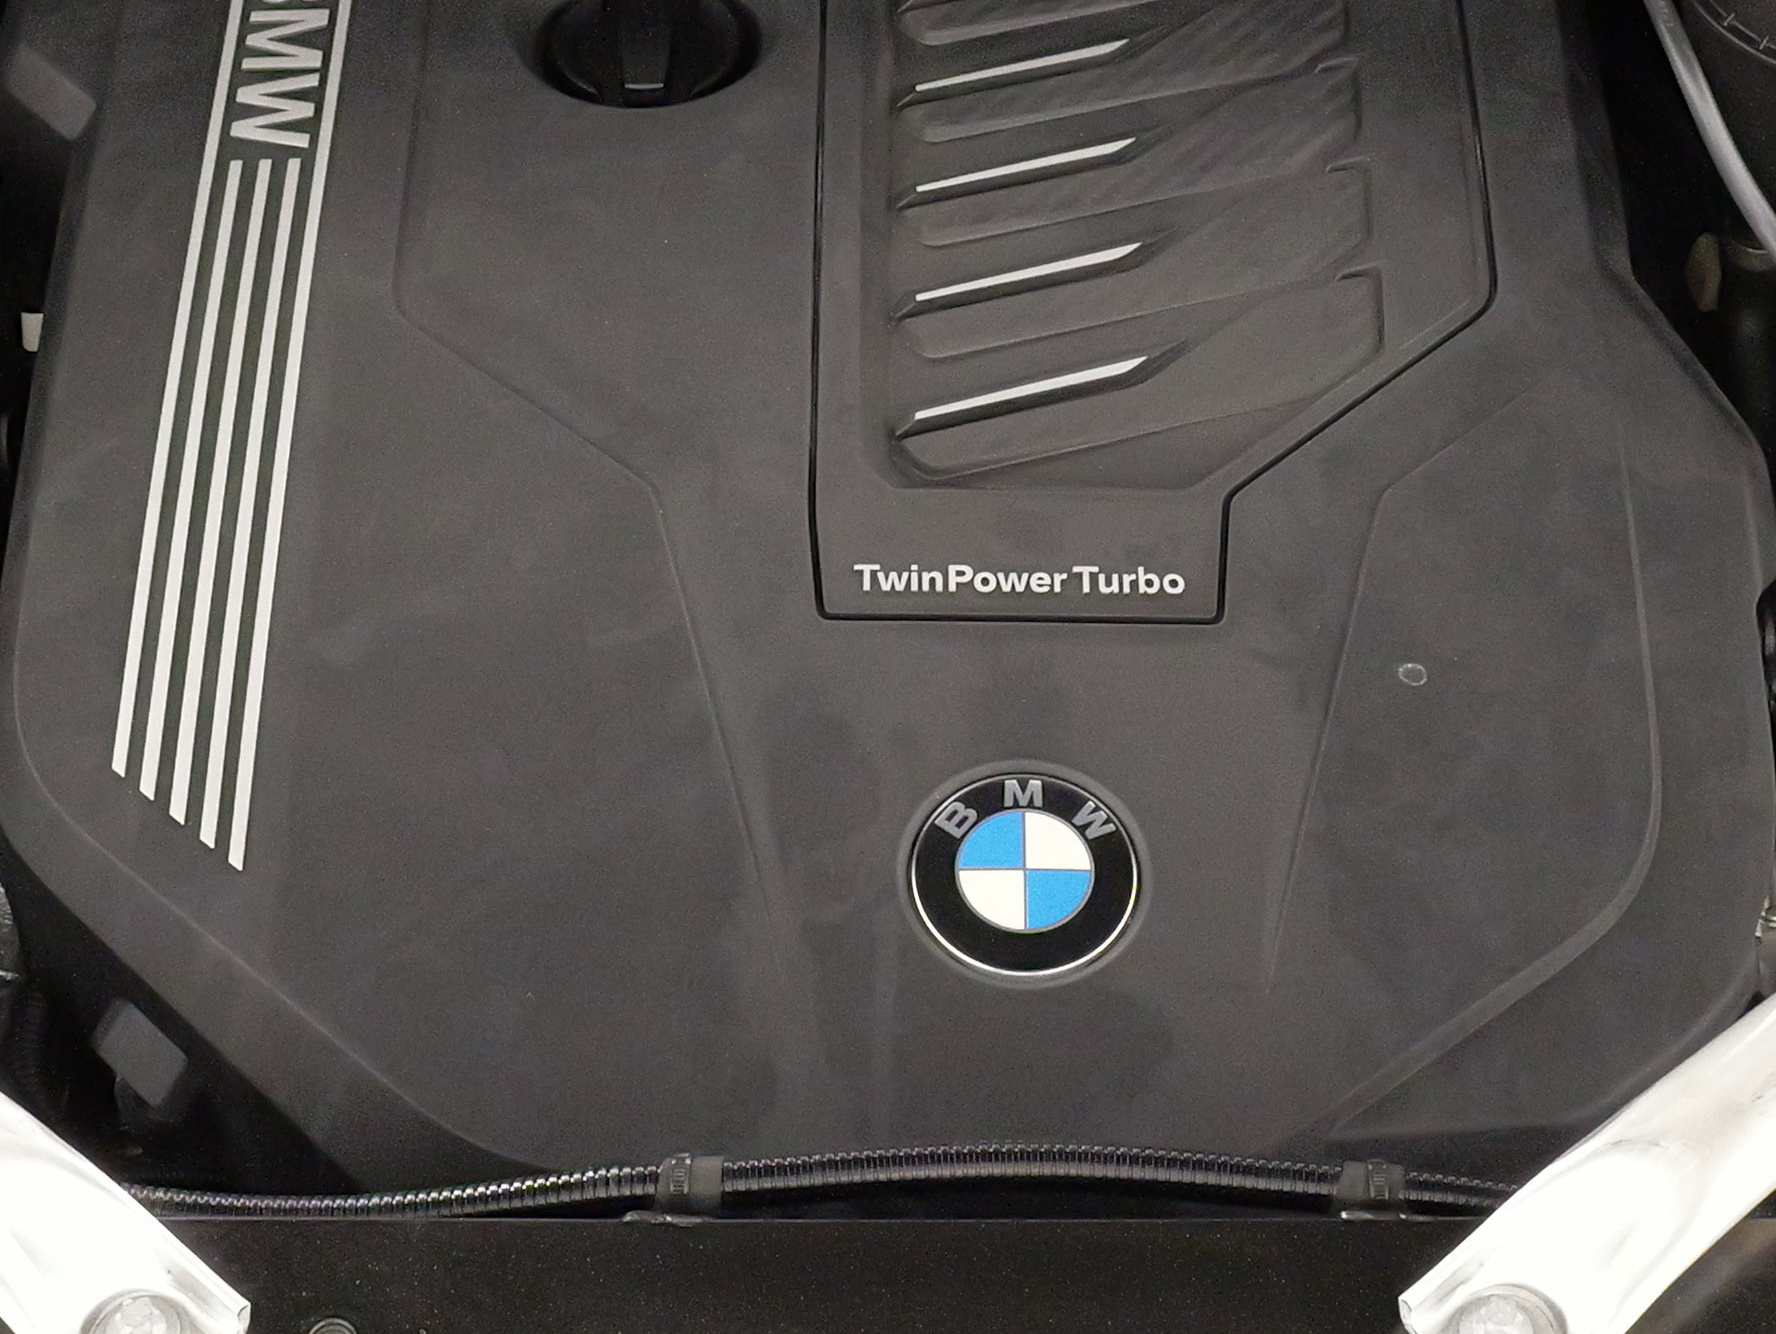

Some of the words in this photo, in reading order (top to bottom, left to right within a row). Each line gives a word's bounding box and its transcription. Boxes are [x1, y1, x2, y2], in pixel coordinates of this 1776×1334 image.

[853, 563, 1068, 594] TwinPower
[1073, 565, 1186, 596] Turbo
[934, 779, 1117, 840] BMW
